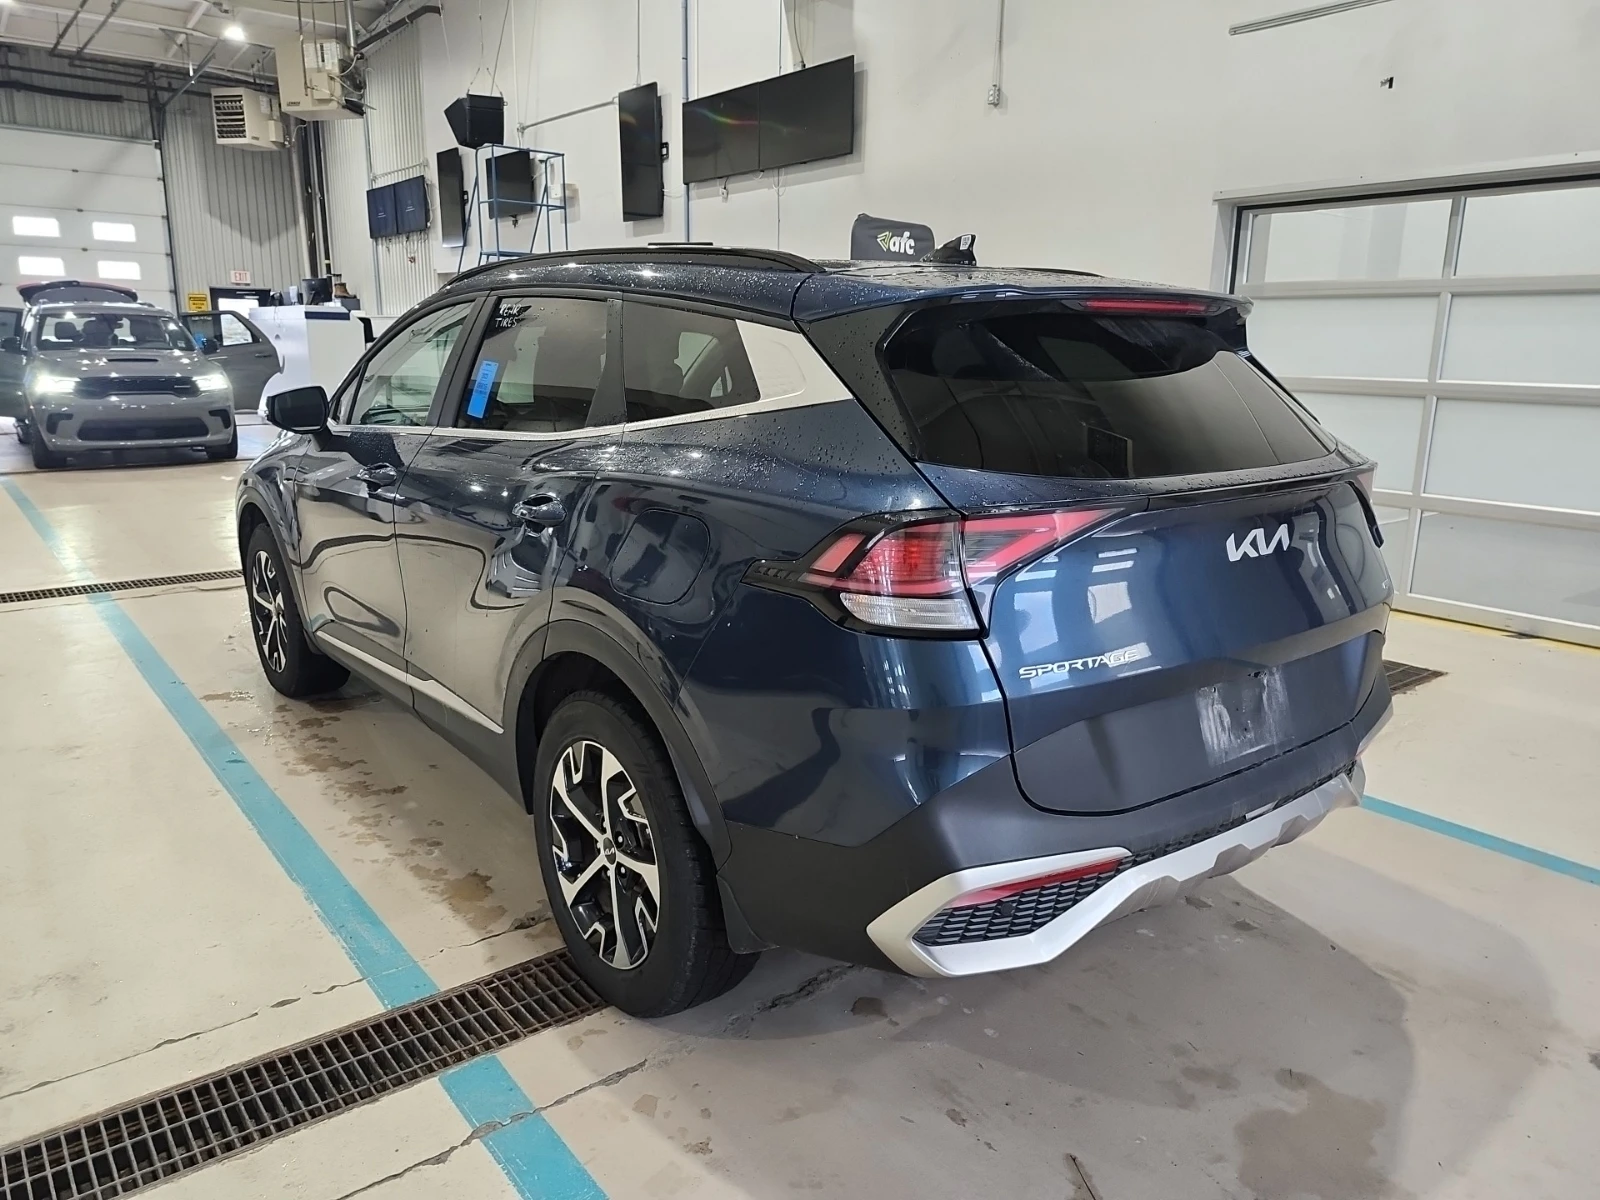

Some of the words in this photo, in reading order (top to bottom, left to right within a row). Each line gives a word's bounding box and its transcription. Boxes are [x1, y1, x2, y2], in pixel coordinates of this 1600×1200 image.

[889, 231, 915, 255] afc
[234, 271, 248, 281] EXIT
[500, 303, 522, 316] REAR
[495, 317, 517, 328] TIRES
[1226, 523, 1290, 562] KIA
[1019, 648, 1138, 679] SPORTAGE
